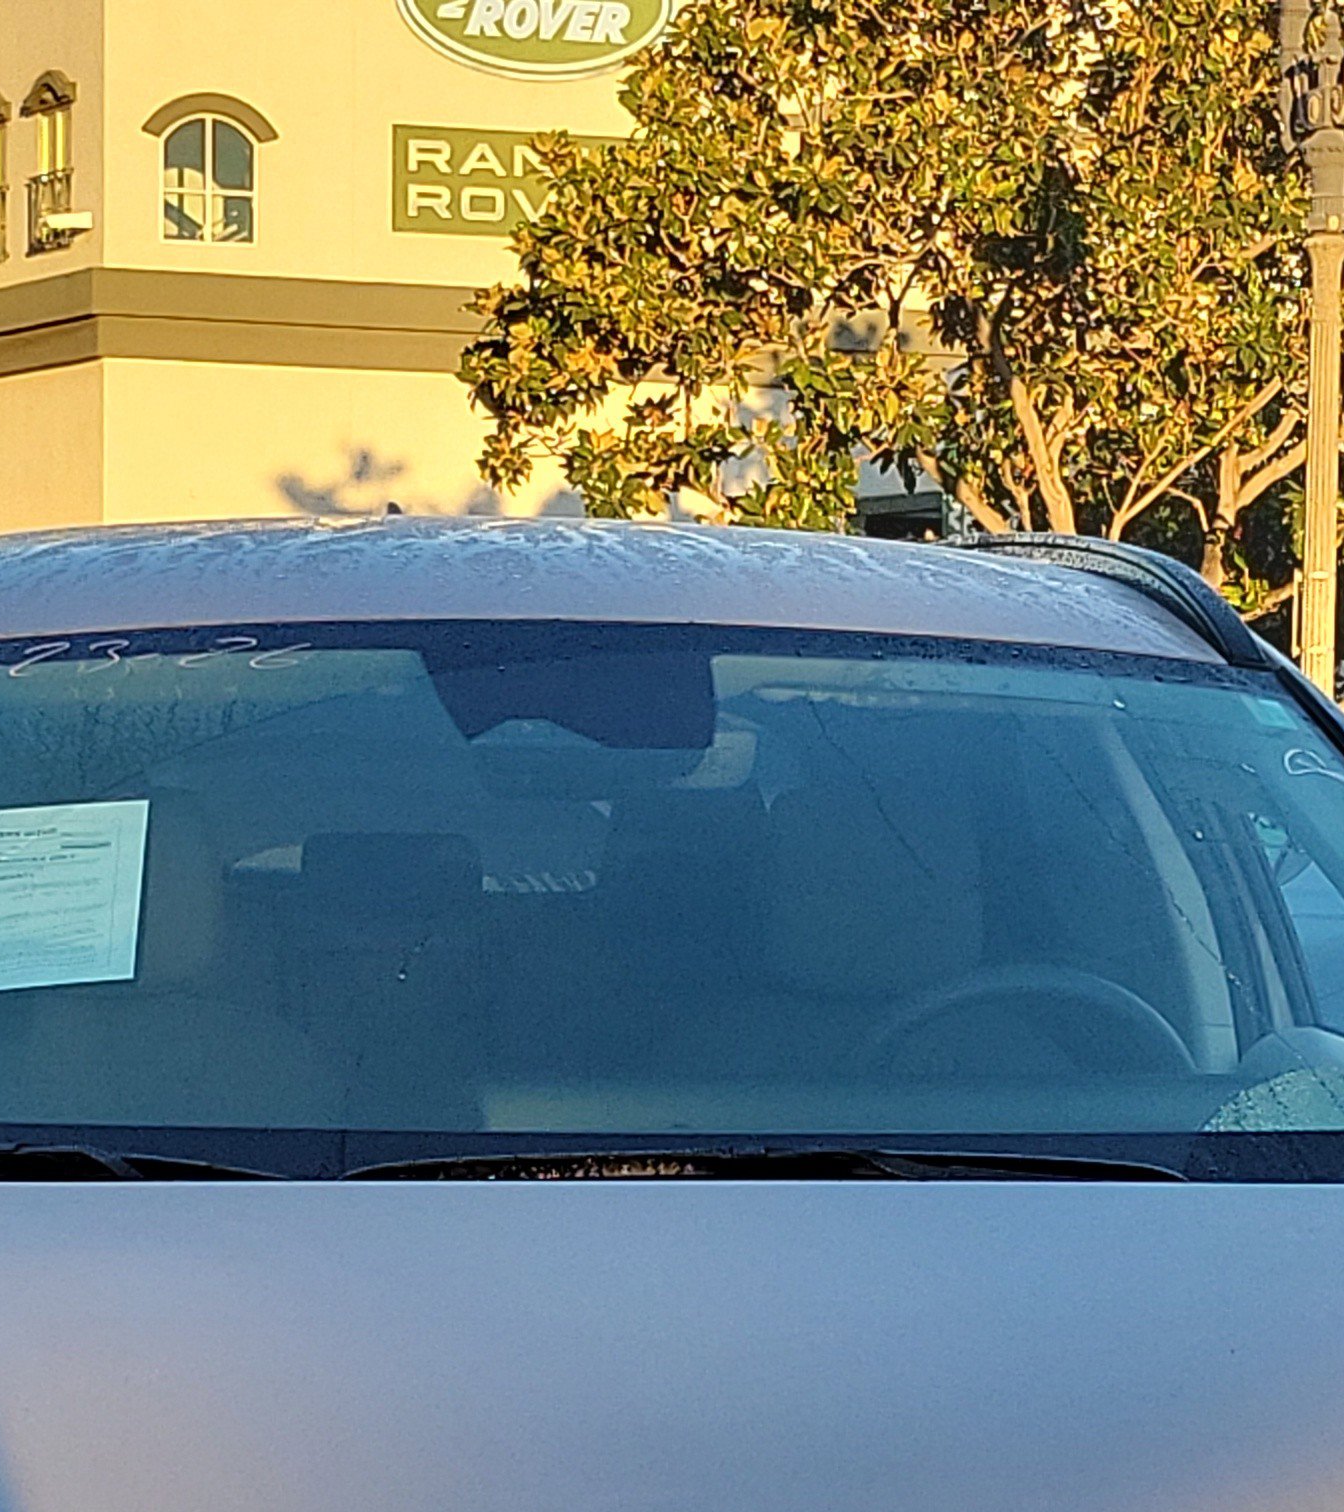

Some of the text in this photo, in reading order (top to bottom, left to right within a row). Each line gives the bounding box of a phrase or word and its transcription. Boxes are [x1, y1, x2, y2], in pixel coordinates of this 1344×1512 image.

[463, 0, 628, 43] ROVER
[407, 139, 556, 177] RAN
[407, 184, 559, 222] ROV
